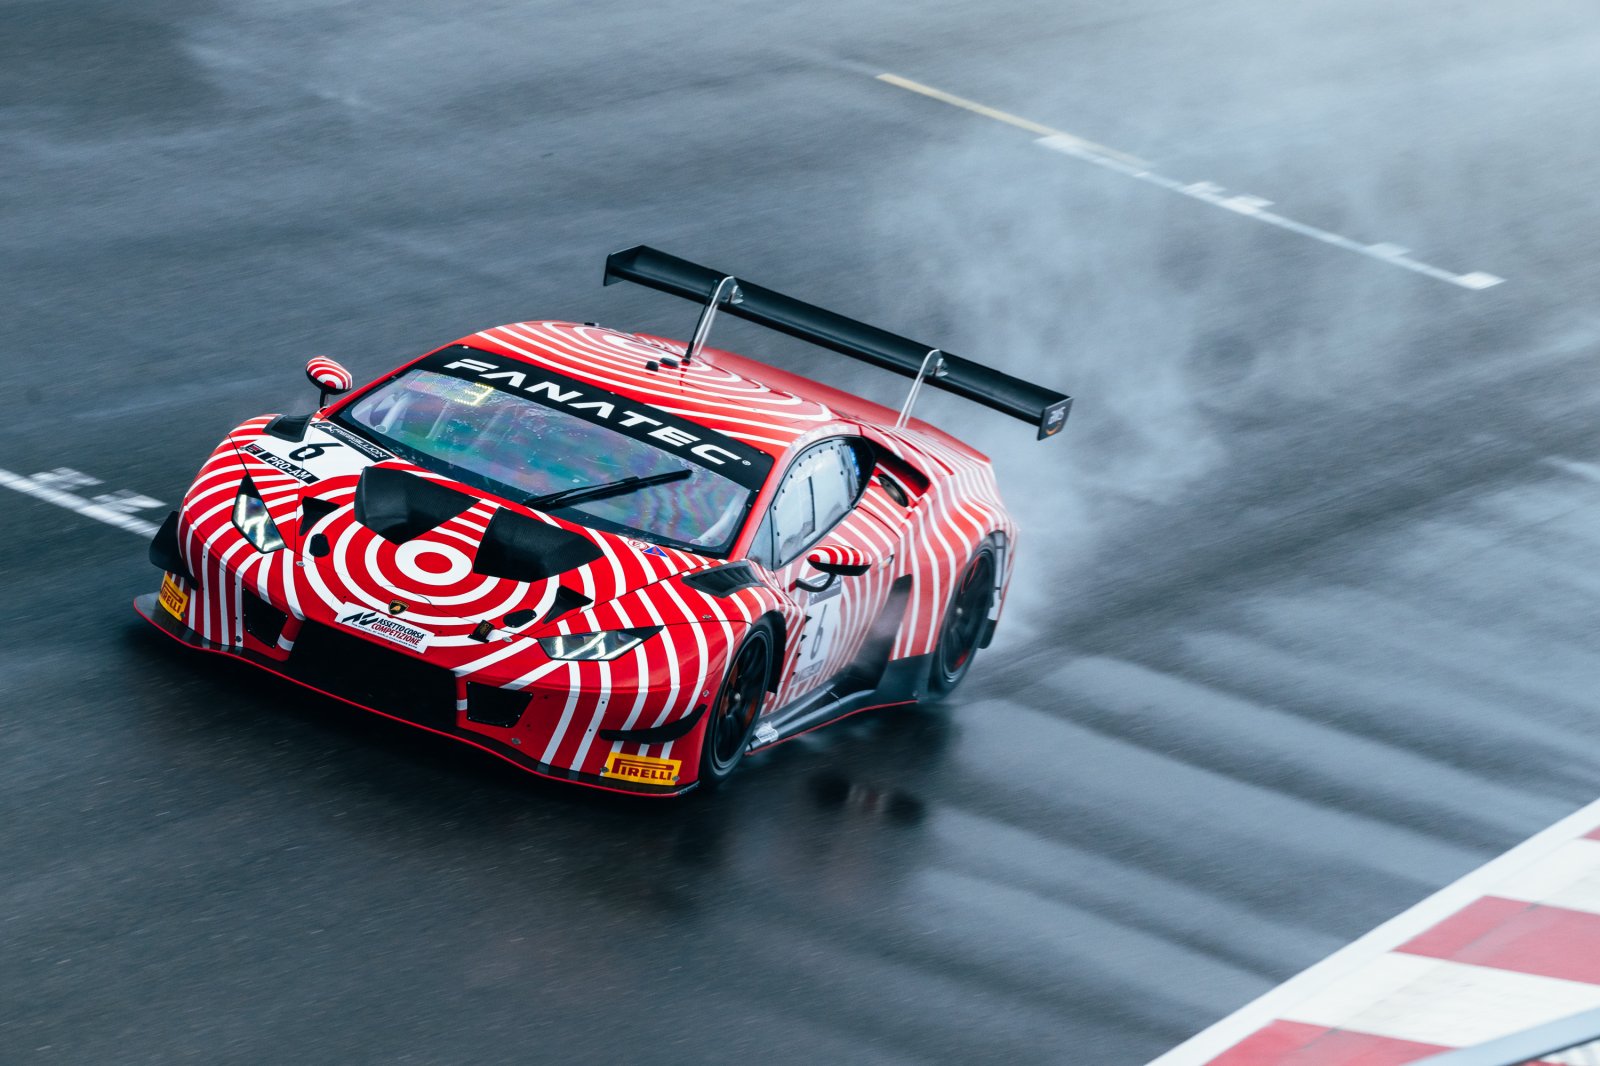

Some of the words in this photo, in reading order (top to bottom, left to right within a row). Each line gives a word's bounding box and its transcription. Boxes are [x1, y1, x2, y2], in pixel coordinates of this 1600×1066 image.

[444, 358, 743, 465] FANATEC
[288, 442, 344, 462] 6
[265, 456, 312, 480] PRO-AM
[371, 623, 421, 646] COMPETIZIONE
[376, 618, 405, 632] ASSETTO
[403, 627, 425, 640] CORSA
[810, 603, 828, 661] 6
[611, 758, 675, 781] PIRELLI
